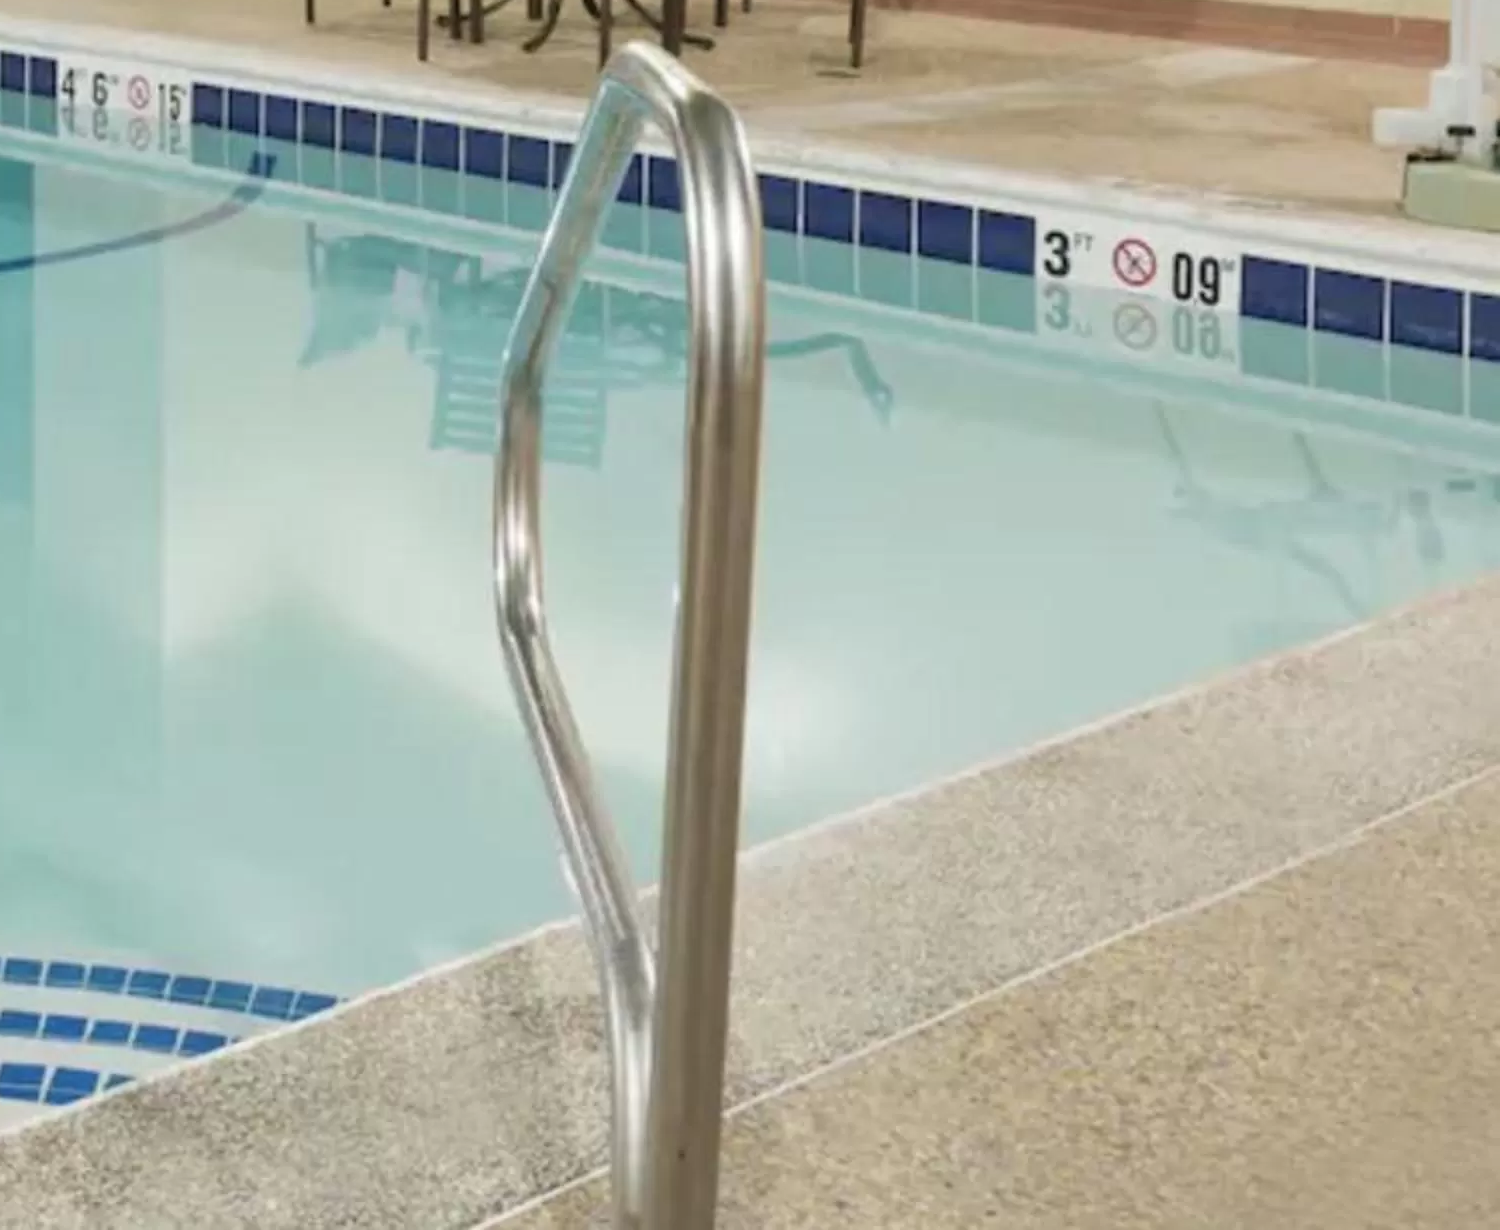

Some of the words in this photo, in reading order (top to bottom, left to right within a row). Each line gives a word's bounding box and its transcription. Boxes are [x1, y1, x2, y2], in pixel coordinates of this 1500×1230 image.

[61, 69, 76, 101] 4
[93, 72, 108, 106] 6
[1043, 231, 1071, 277] 3
